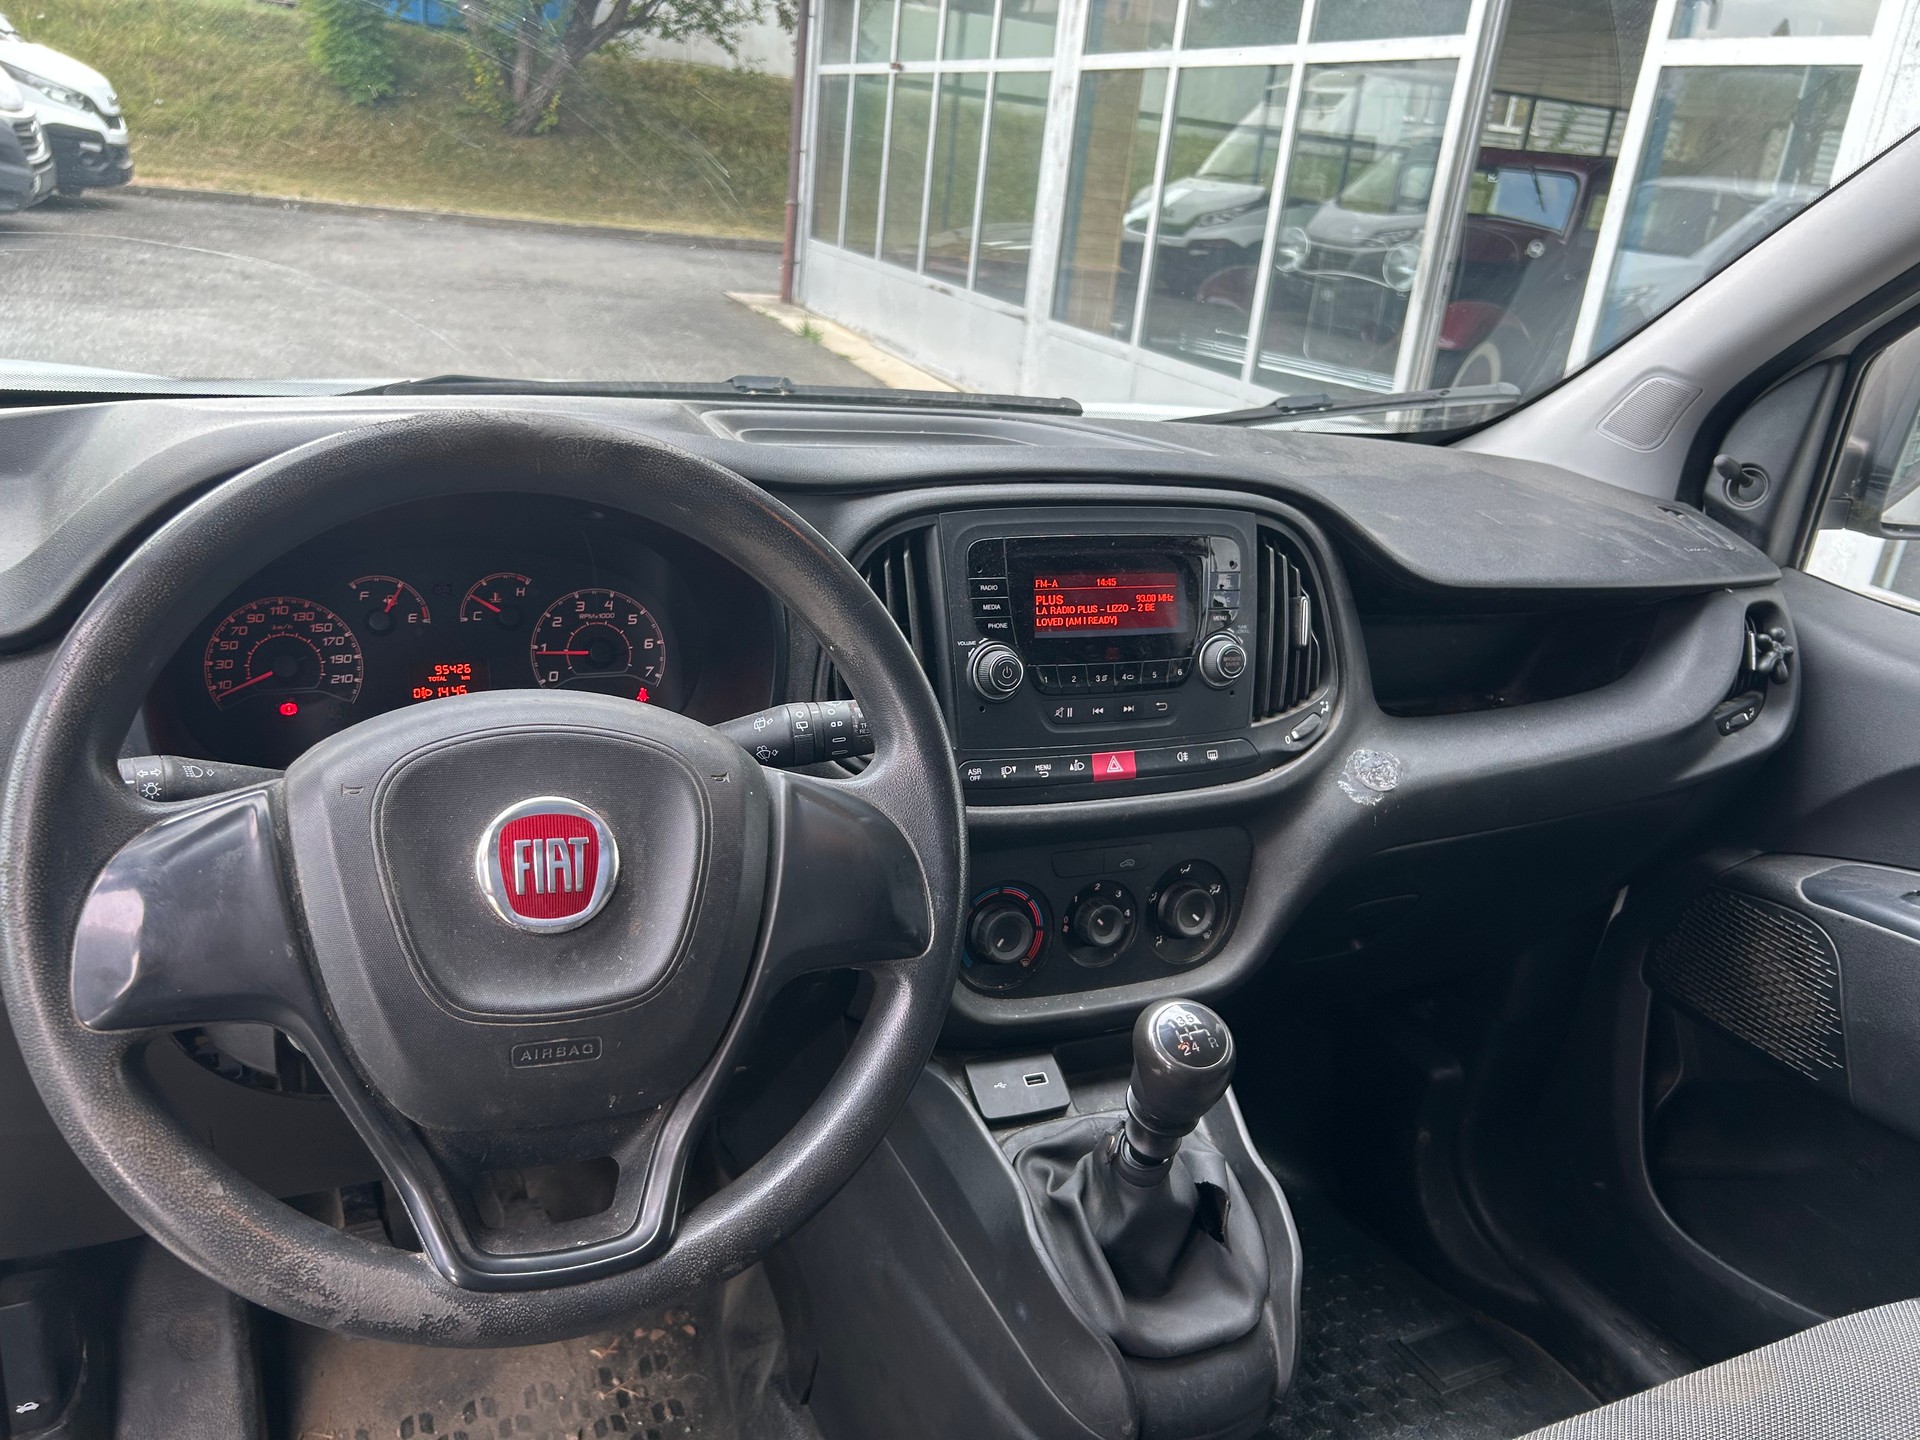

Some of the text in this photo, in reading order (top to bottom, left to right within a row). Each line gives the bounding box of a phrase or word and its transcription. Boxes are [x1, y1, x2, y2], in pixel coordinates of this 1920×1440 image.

[1035, 577, 1117, 588] FM-A 14:45
[359, 591, 370, 601] F
[516, 587, 526, 597] H
[1035, 593, 1174, 606] PLUS 93.00 MHz
[270, 605, 289, 615] 110
[575, 601, 585, 612] 3
[604, 600, 614, 611] 4
[1035, 606, 1048, 615] LA
[1050, 605, 1075, 614] RADIO
[1077, 605, 1098, 614] PLUS
[1106, 604, 1129, 613] LIZZO
[1137, 603, 1143, 612] 2
[1145, 603, 1155, 612] BE
[246, 613, 265, 623] 90
[292, 612, 315, 621] 130
[407, 613, 418, 624] E
[472, 610, 482, 621] C
[628, 614, 638, 625] 5
[552, 616, 562, 627] 2
[1036, 617, 1064, 627] LOVED
[1065, 617, 1082, 628] (AM
[1087, 615, 1118, 626] READY)
[231, 626, 248, 636] 70
[310, 623, 333, 633] 150
[220, 640, 239, 650] 50
[322, 636, 345, 647] 170
[643, 638, 654, 649] 6
[214, 659, 234, 669] 30
[330, 654, 352, 664] 190
[434, 663, 472, 675] 95426
[645, 666, 655, 677] 7
[1177, 668, 1183, 676] 6
[331, 673, 354, 684] 210
[548, 671, 559, 682] 0
[1071, 675, 1077, 683] 2
[1095, 674, 1101, 682] 3
[1152, 671, 1157, 679] 5
[217, 680, 232, 690] 10
[967, 767, 982, 776] ASR
[513, 836, 590, 896] FIAT
[1094, 882, 1101, 891] 2
[1115, 889, 1122, 898] 3
[1124, 908, 1130, 918] 4
[1176, 1016, 1186, 1027] 3
[1186, 1013, 1195, 1023] 5
[1182, 1036, 1219, 1056] 2 4 R
[520, 1043, 594, 1062] AIRBAG
